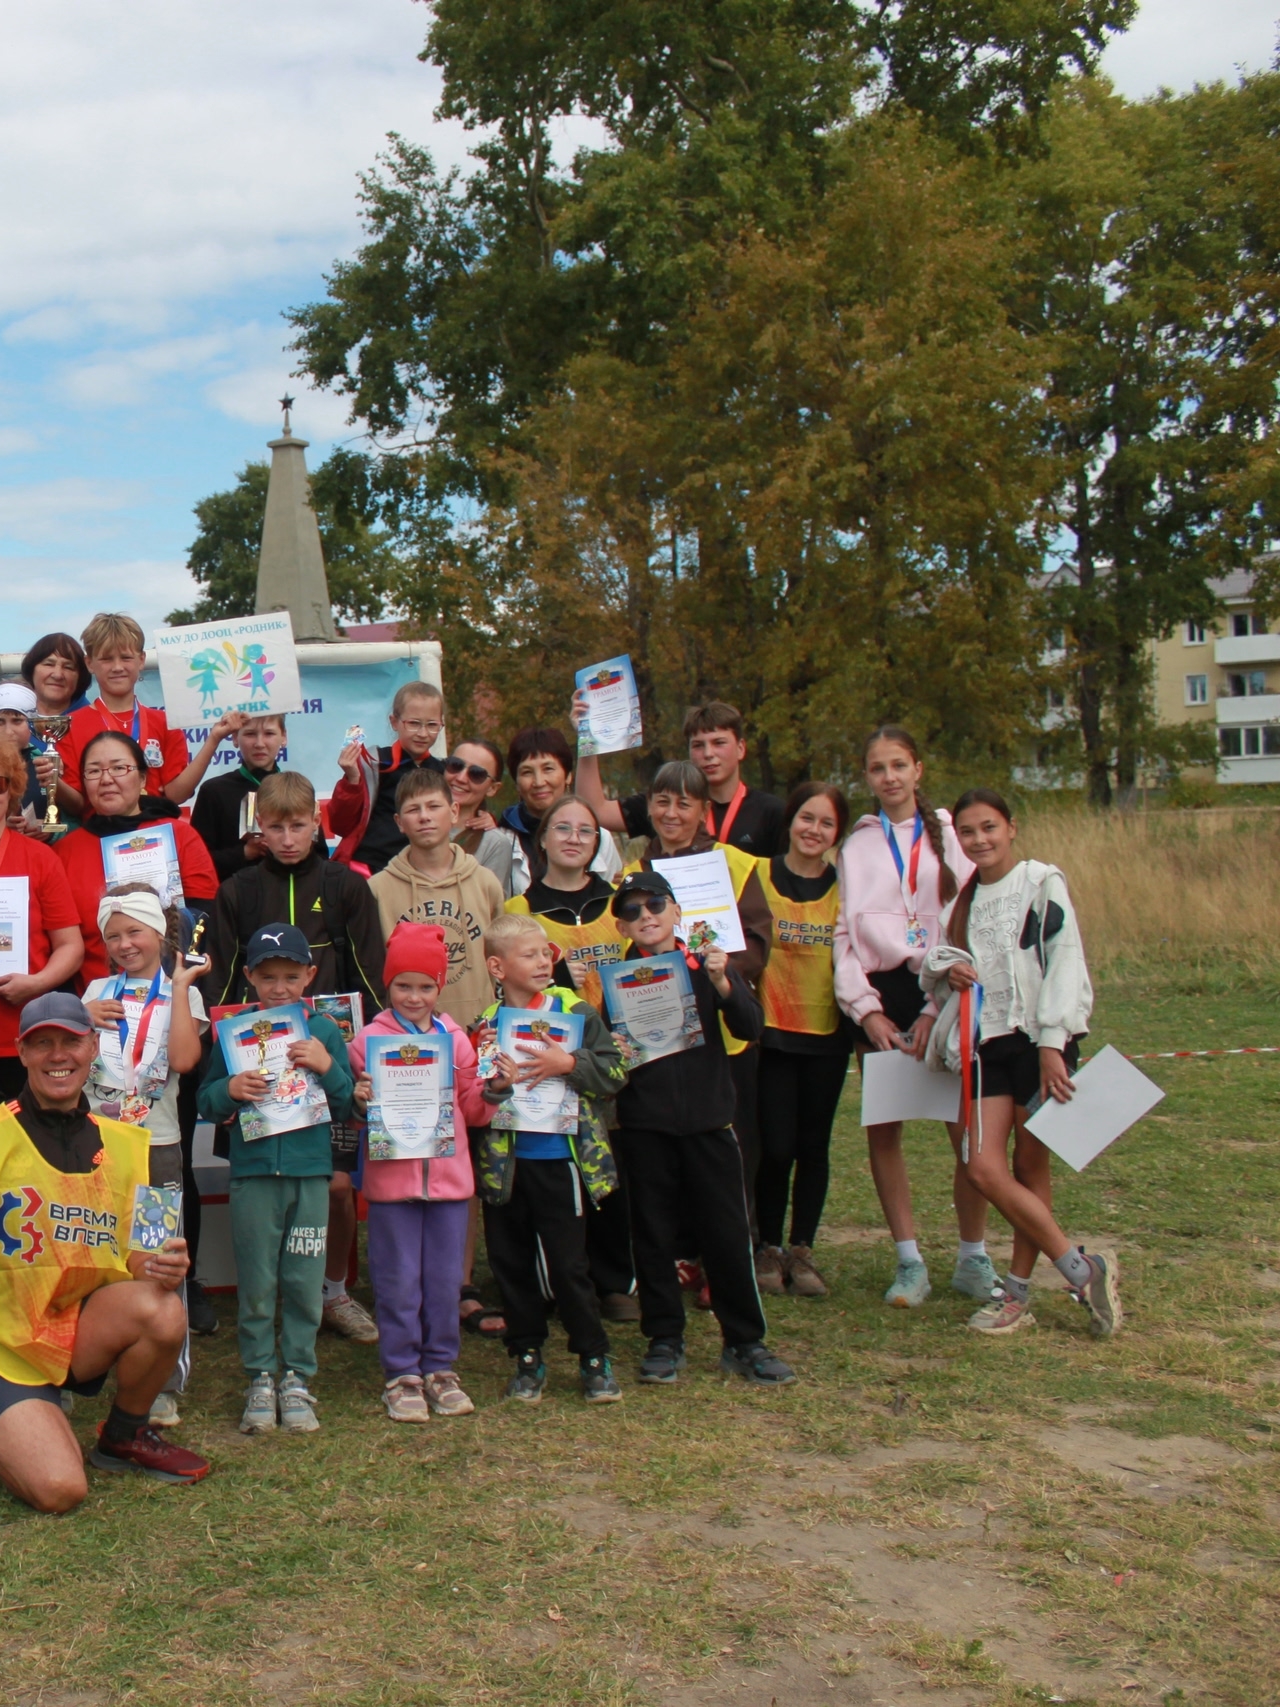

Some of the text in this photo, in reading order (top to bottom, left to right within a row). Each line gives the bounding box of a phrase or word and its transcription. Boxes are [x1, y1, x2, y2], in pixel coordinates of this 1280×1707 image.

[160, 620, 287, 646] МАУ ДО ДООЦ «РОДНИК»
[593, 686, 622, 699] ГРАМОТА
[121, 851, 158, 862] ГРАМОТА
[778, 920, 832, 933] ВРЕМЯ
[779, 932, 832, 946] ВПЕРЕ
[626, 985, 669, 998] ГРАМОТА
[387, 1069, 431, 1078] ГРАМОТА
[50, 1202, 118, 1231] ВРЕМЯ
